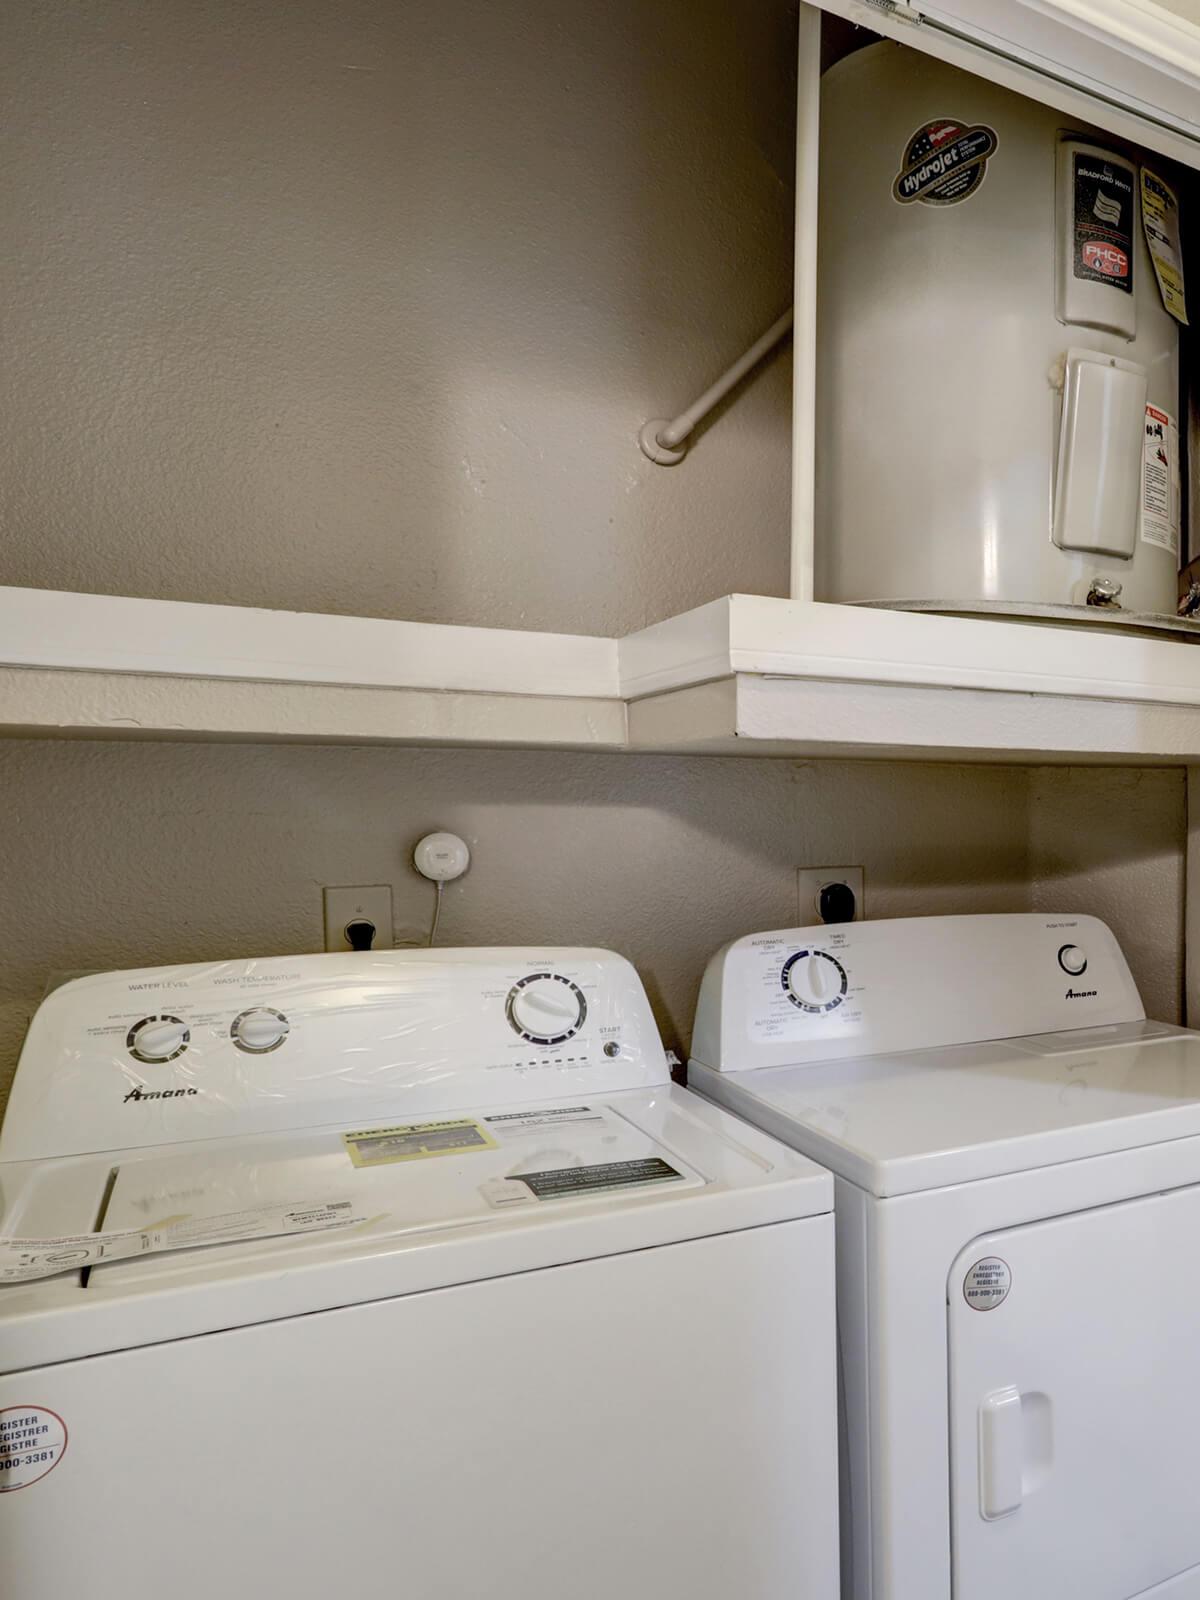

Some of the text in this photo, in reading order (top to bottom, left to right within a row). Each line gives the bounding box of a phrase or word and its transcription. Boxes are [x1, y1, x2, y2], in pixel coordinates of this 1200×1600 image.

[904, 148, 958, 192] Hydrojet
[1078, 168, 1113, 184] BRADFORD
[1086, 246, 1127, 265] PHCC
[128, 981, 189, 992] WATER LEVEL
[213, 976, 240, 985] WASH
[1065, 988, 1098, 1000] Amana
[600, 1026, 621, 1034] START
[123, 1085, 199, 1104] Amana
